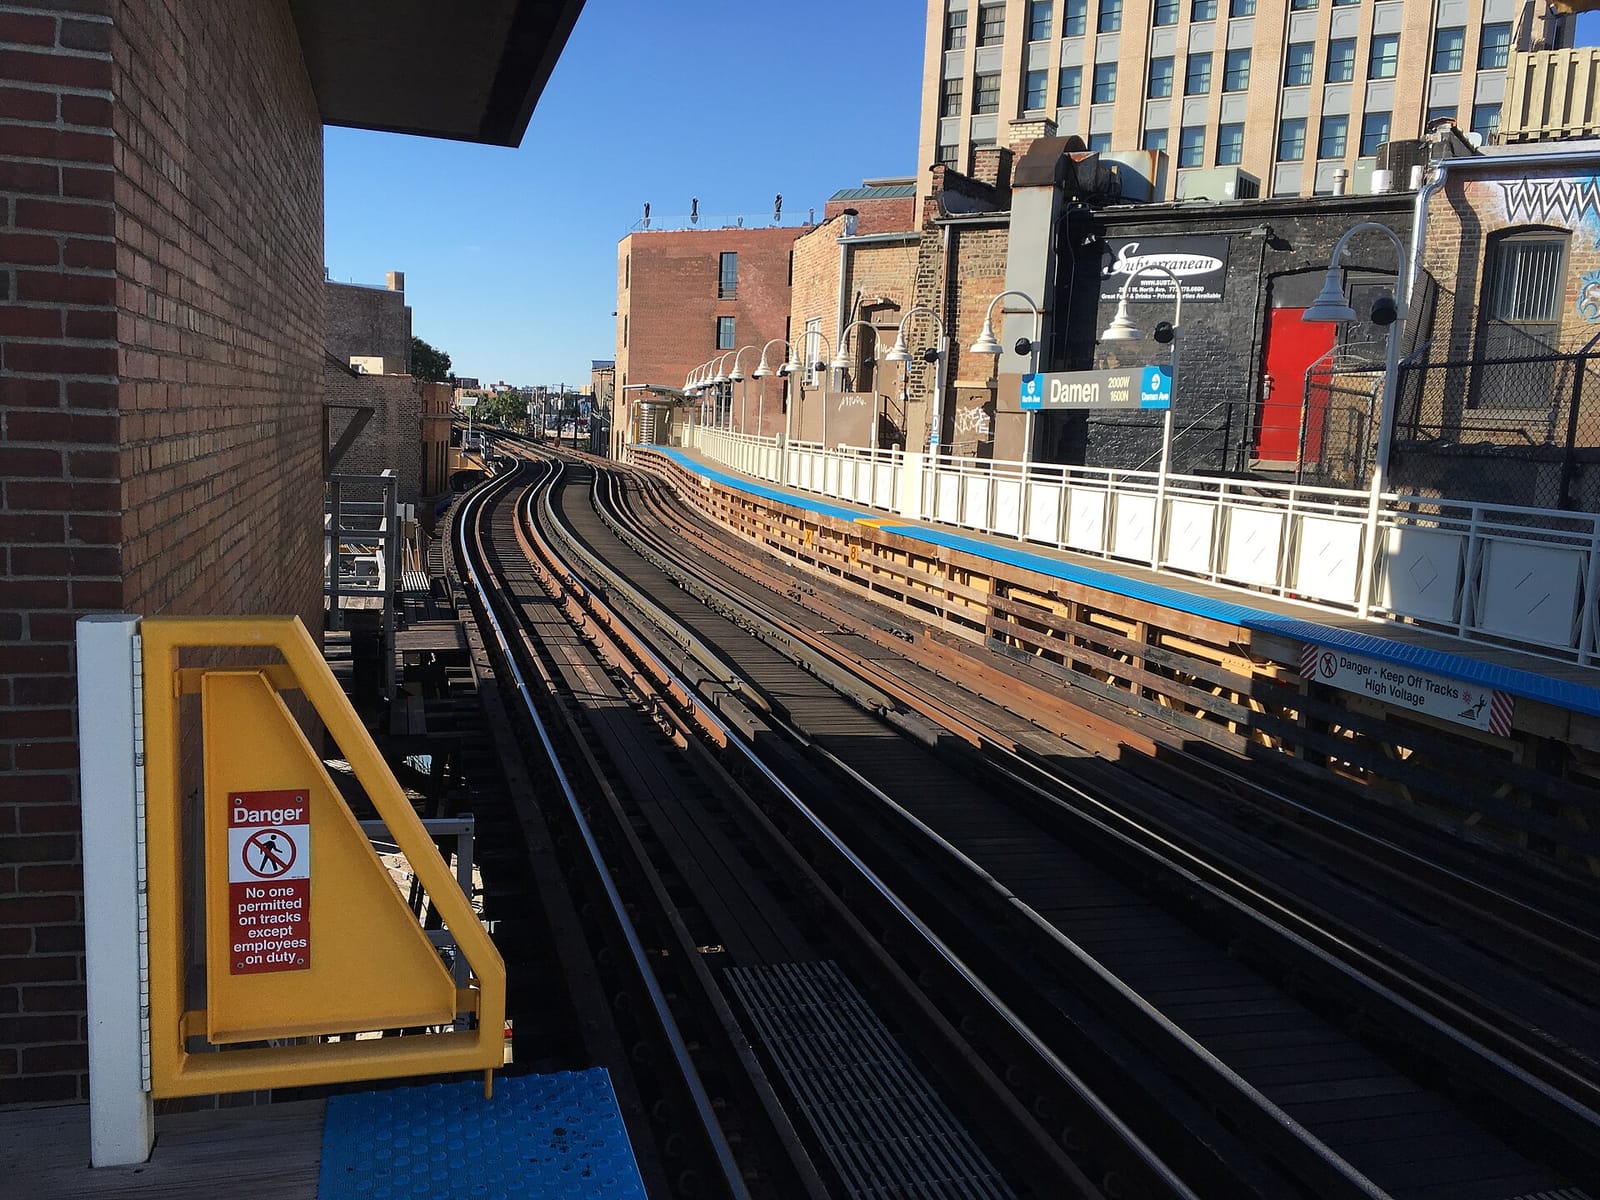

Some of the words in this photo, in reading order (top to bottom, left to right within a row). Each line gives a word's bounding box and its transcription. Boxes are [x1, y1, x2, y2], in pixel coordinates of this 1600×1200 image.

[1108, 376, 1130, 388] 2000W
[1050, 379, 1099, 403] Damen
[1110, 391, 1129, 402] 1600N
[1340, 657, 1372, 676] Danger
[1380, 668, 1403, 685] Keep
[1406, 674, 1423, 689] Off
[1425, 679, 1459, 699] Tracks
[1365, 678, 1387, 695] High
[1389, 684, 1425, 707] Voltage
[233, 807, 303, 825] Danger
[245, 887, 265, 899] No
[268, 886, 295, 897] one
[238, 898, 302, 915] permitted
[239, 915, 257, 926] on
[259, 912, 301, 924] tracks
[248, 925, 293, 940] except
[233, 938, 307, 954] employees
[245, 955, 263, 965] on
[266, 952, 297, 965] duty
